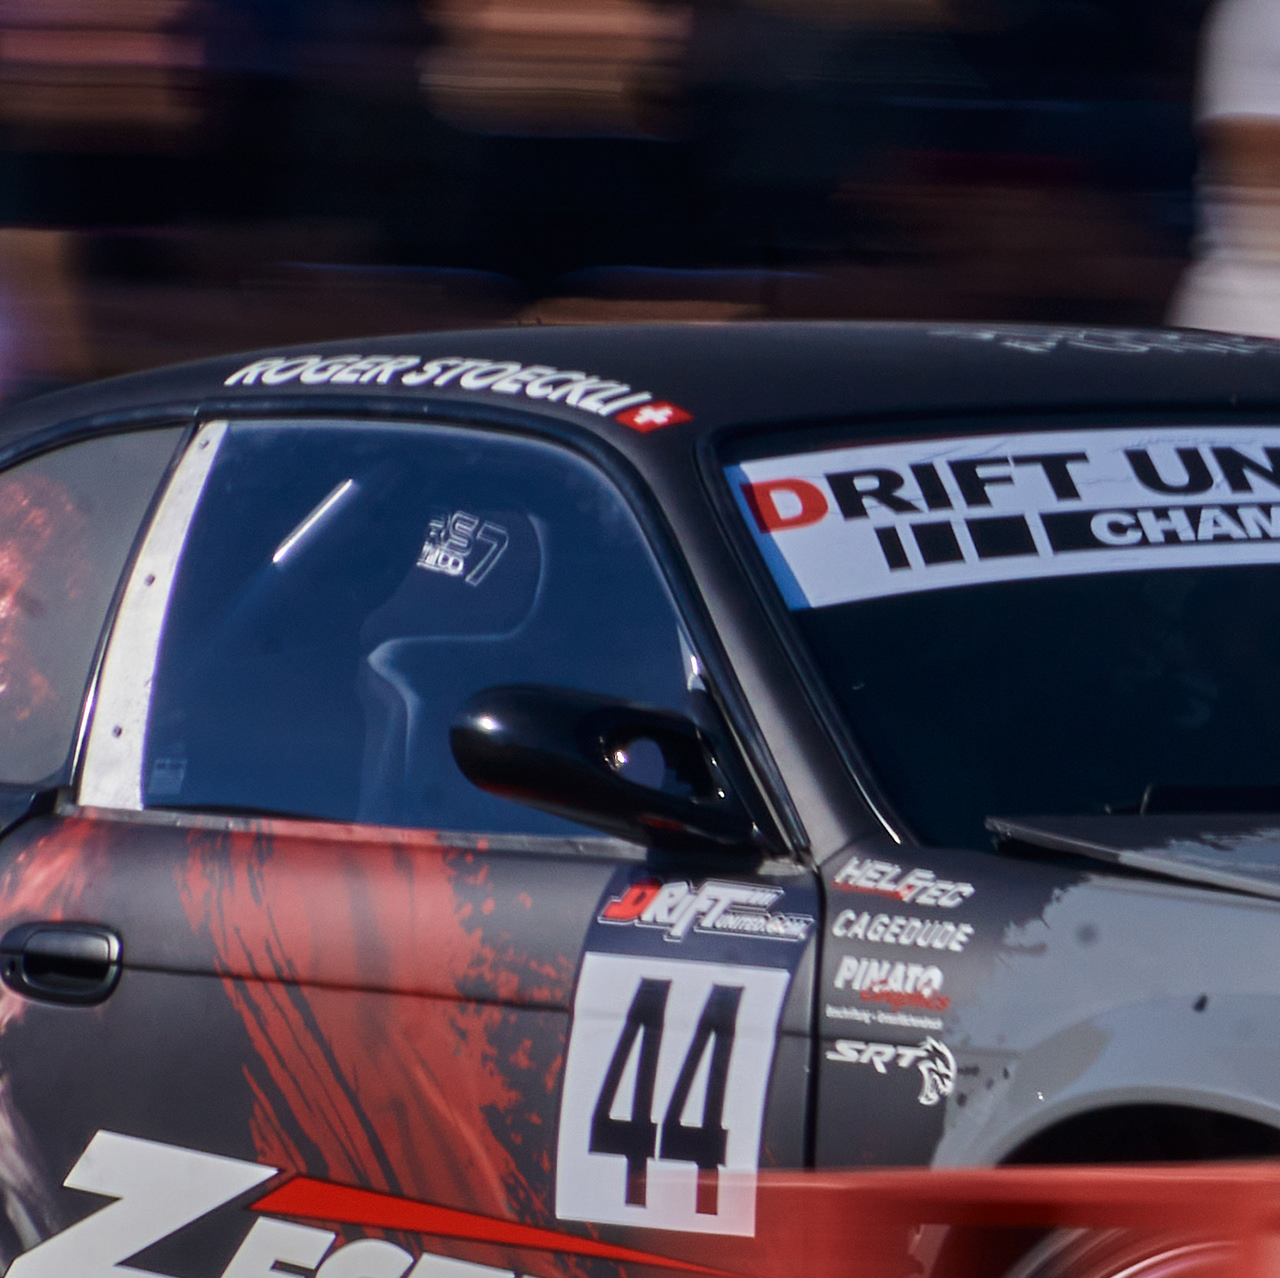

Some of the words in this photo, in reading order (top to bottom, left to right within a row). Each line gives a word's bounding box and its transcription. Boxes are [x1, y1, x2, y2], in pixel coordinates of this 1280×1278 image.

[225, 355, 408, 385] ROGER
[402, 358, 653, 416] STOECKLI
[742, 451, 1088, 533] DRIFT
[832, 909, 974, 951] CAGEDUDE
[835, 956, 943, 998] PINATO
[826, 1038, 928, 1074] SRT
[588, 977, 745, 1215] 44
